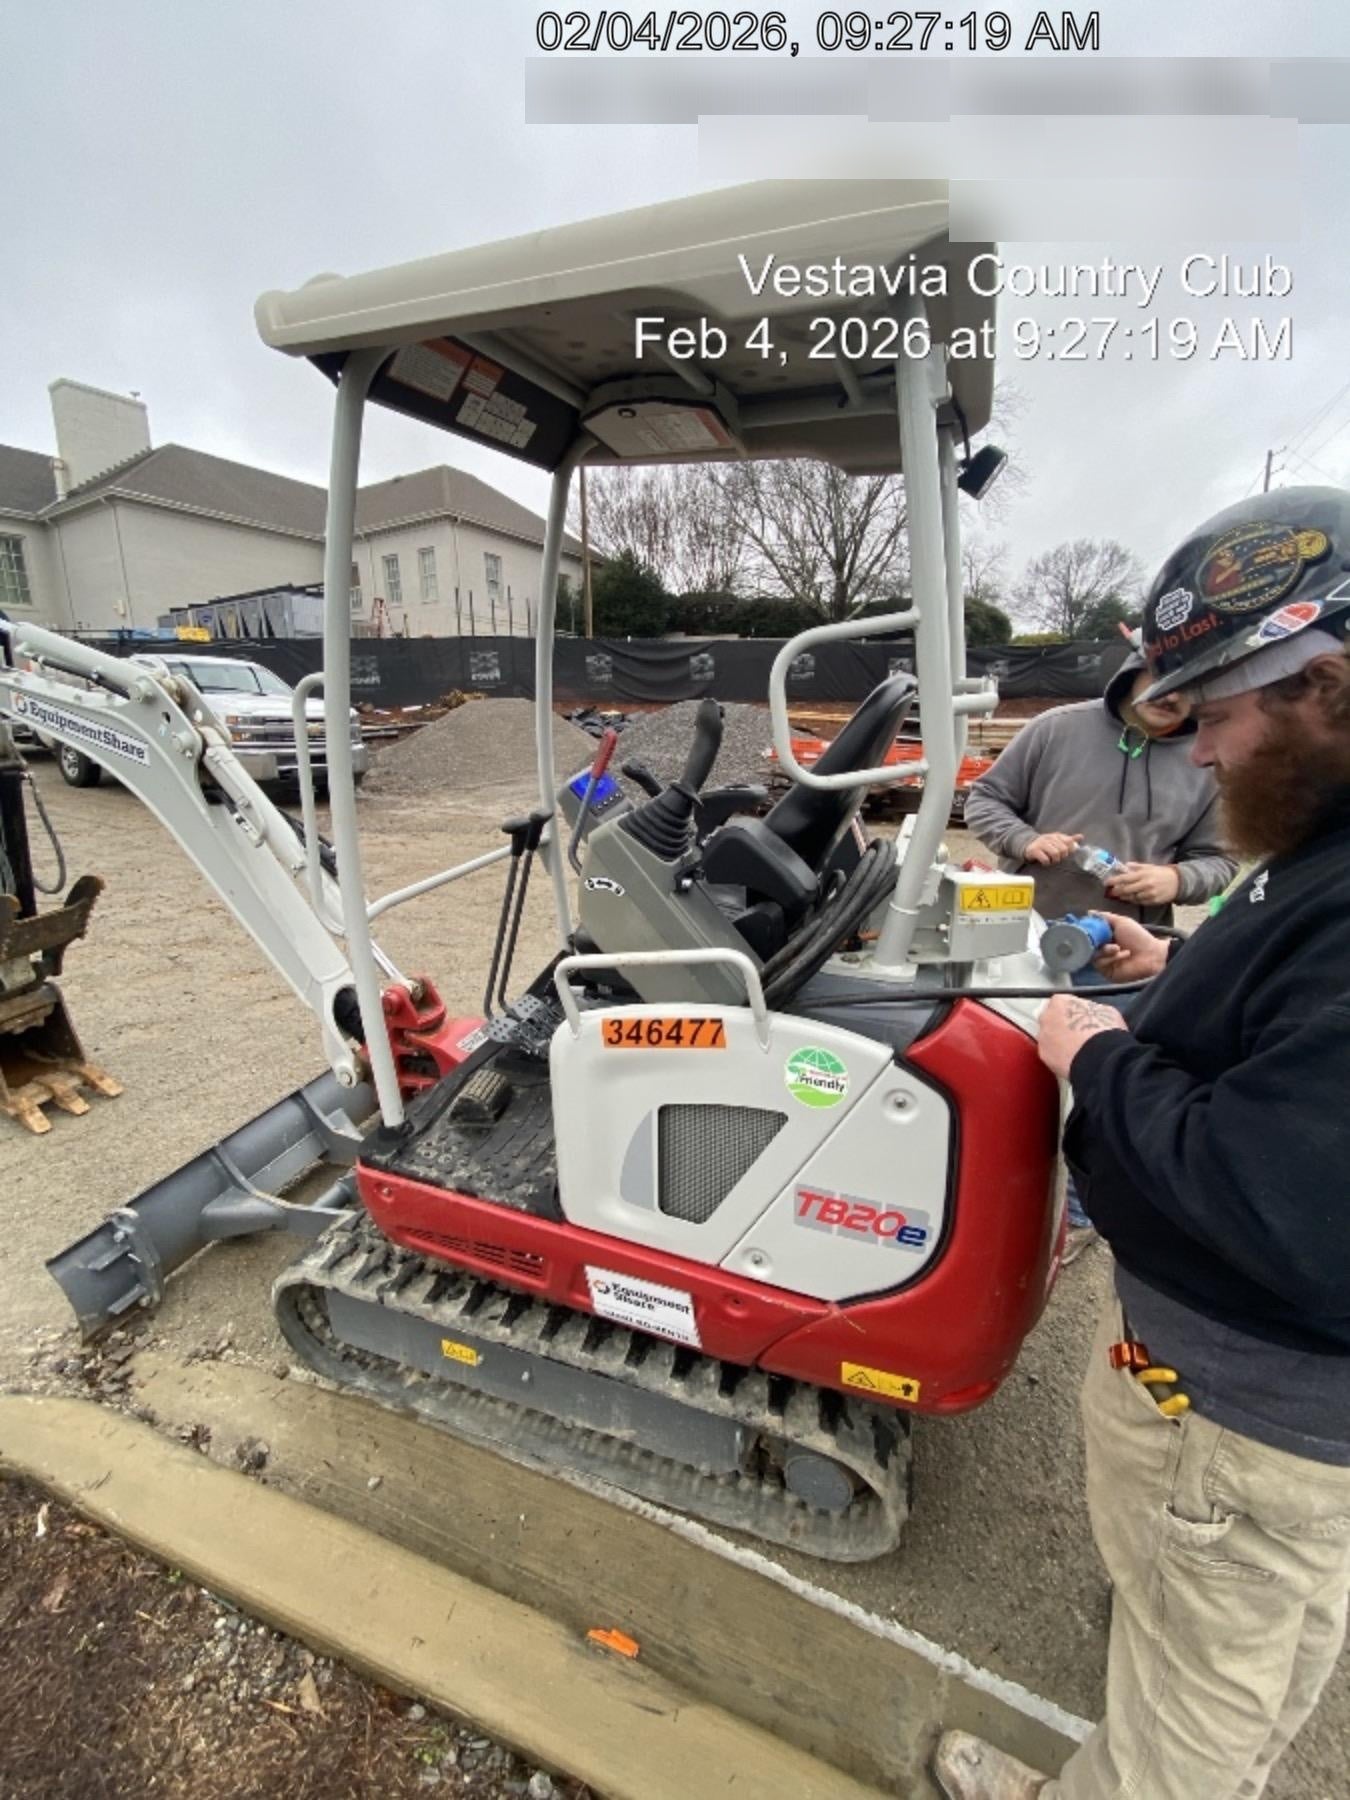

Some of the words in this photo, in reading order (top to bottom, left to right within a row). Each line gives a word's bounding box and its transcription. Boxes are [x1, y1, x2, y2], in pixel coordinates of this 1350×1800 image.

[29, 700, 146, 760] EquipmentShare
[606, 1018, 725, 1046] 346477
[800, 1074, 845, 1093] Friendly
[797, 1190, 927, 1247] TB20e
[611, 1281, 690, 1315] Equipment
[613, 1290, 656, 1312] Share
